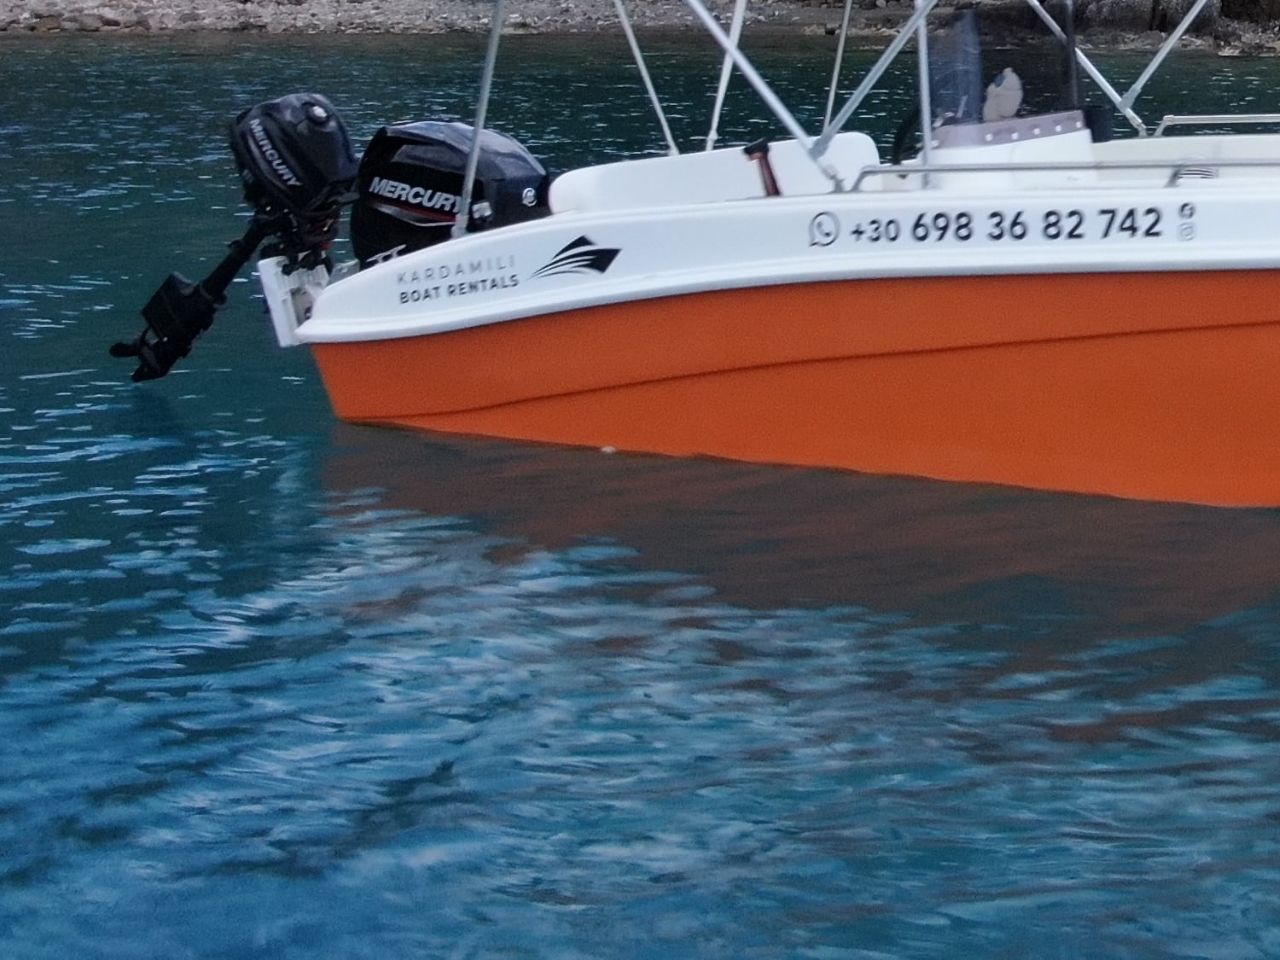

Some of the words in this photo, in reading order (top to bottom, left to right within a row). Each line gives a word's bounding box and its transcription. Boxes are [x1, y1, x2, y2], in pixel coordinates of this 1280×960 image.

[249, 118, 303, 187] MERCURY
[851, 218, 900, 243] +30
[911, 211, 973, 242] 698
[987, 210, 1028, 241] 36
[1043, 209, 1085, 240] 82
[1098, 206, 1162, 239] 742
[397, 254, 515, 284] KARDAMILI
[399, 285, 441, 305] BOAT
[446, 273, 520, 297] RENTALS
